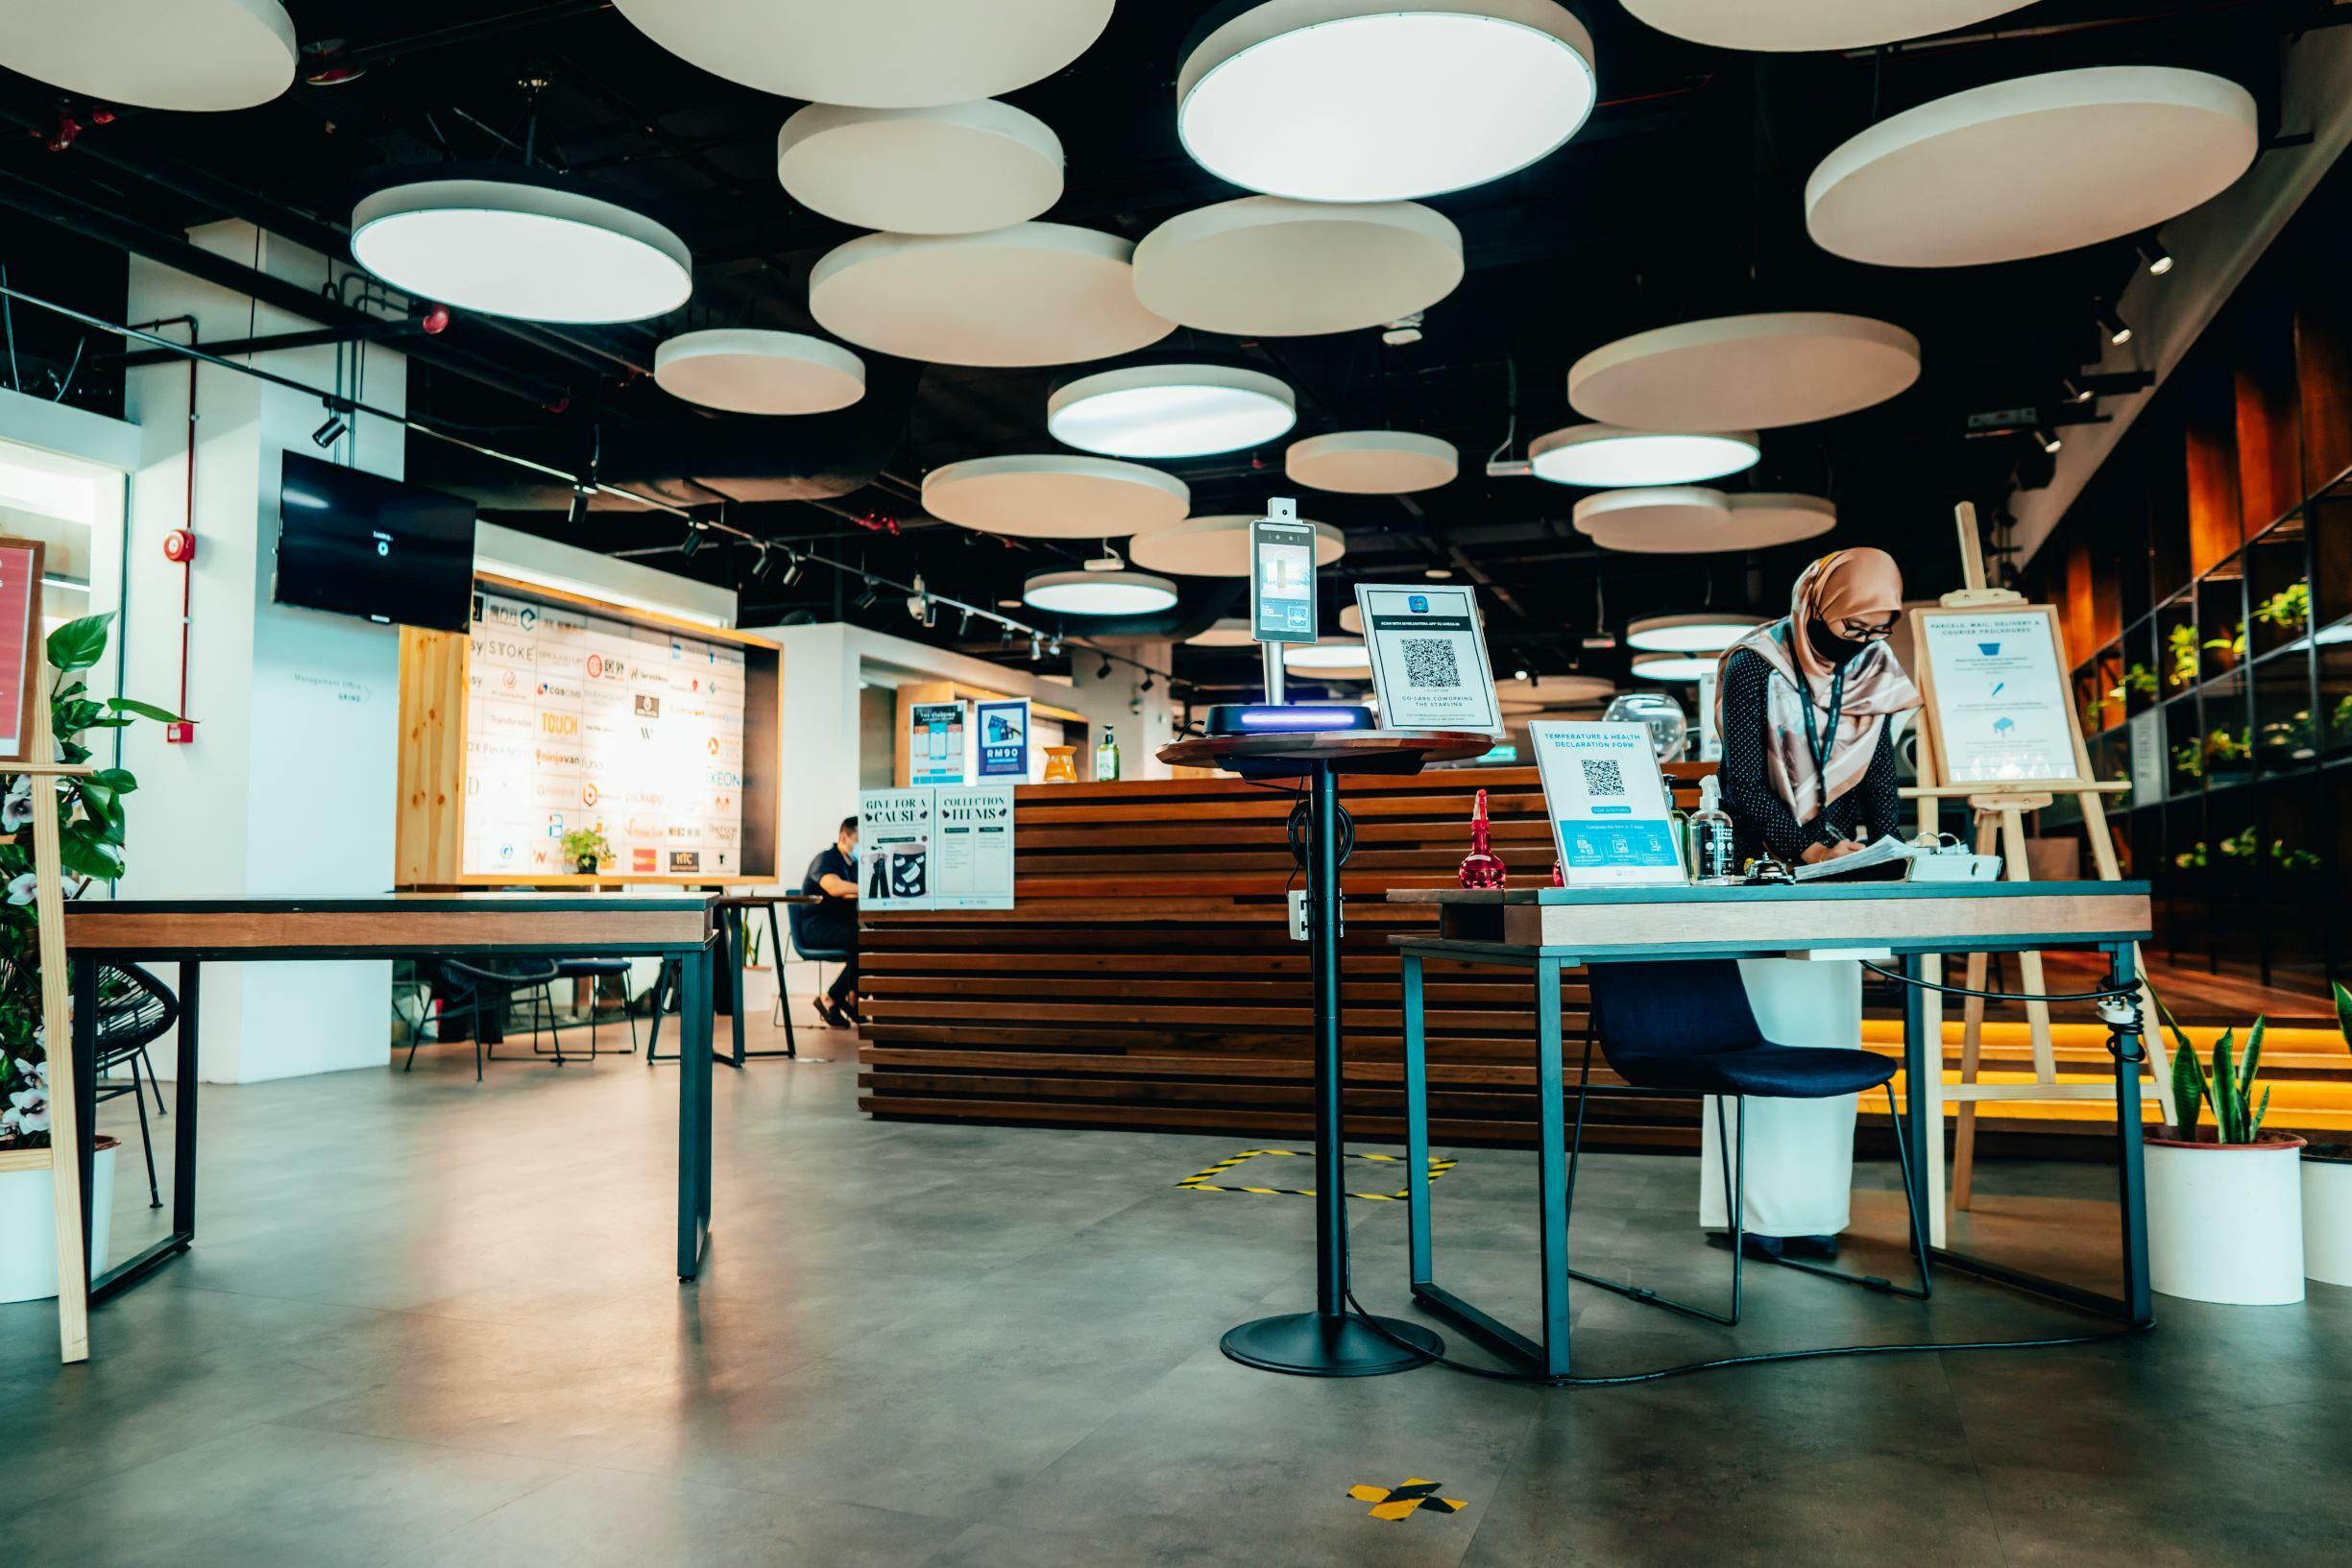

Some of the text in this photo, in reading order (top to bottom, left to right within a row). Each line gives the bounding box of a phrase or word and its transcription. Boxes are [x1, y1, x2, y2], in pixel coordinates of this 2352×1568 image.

[542, 712, 578, 737] TOUCH
[986, 748, 1018, 759] RM90
[866, 800, 889, 810] GIVE
[895, 799, 916, 809] FOR
[944, 797, 1006, 808] COLLECTION
[874, 810, 917, 823] CAUSE
[953, 808, 996, 820] ITEMS
